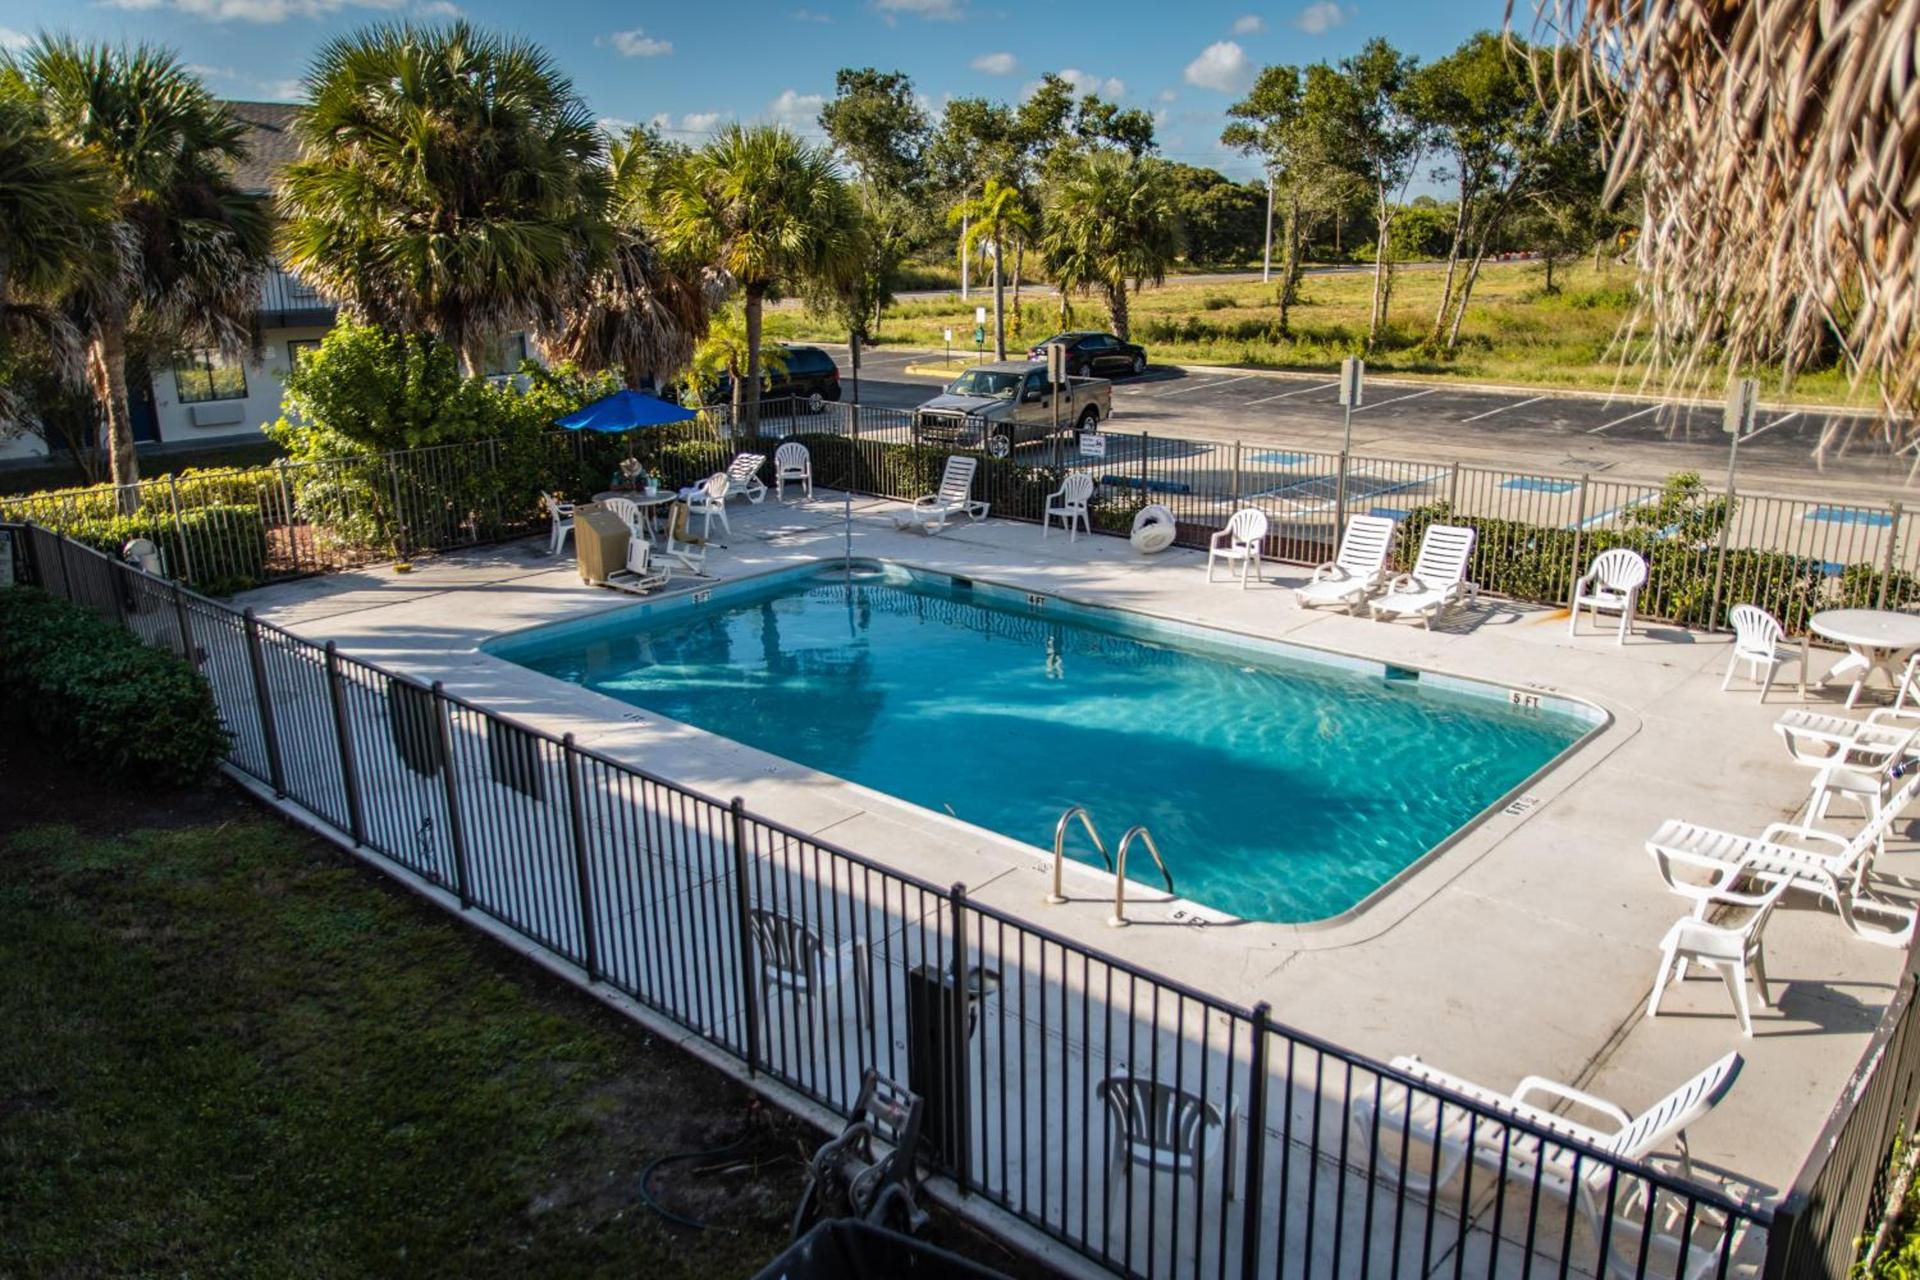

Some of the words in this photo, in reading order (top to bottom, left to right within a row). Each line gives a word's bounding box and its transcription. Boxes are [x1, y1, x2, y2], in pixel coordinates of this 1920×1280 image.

[1513, 692, 1521, 704] 5
[1525, 695, 1539, 707] FT
[1173, 910, 1188, 919] 5
